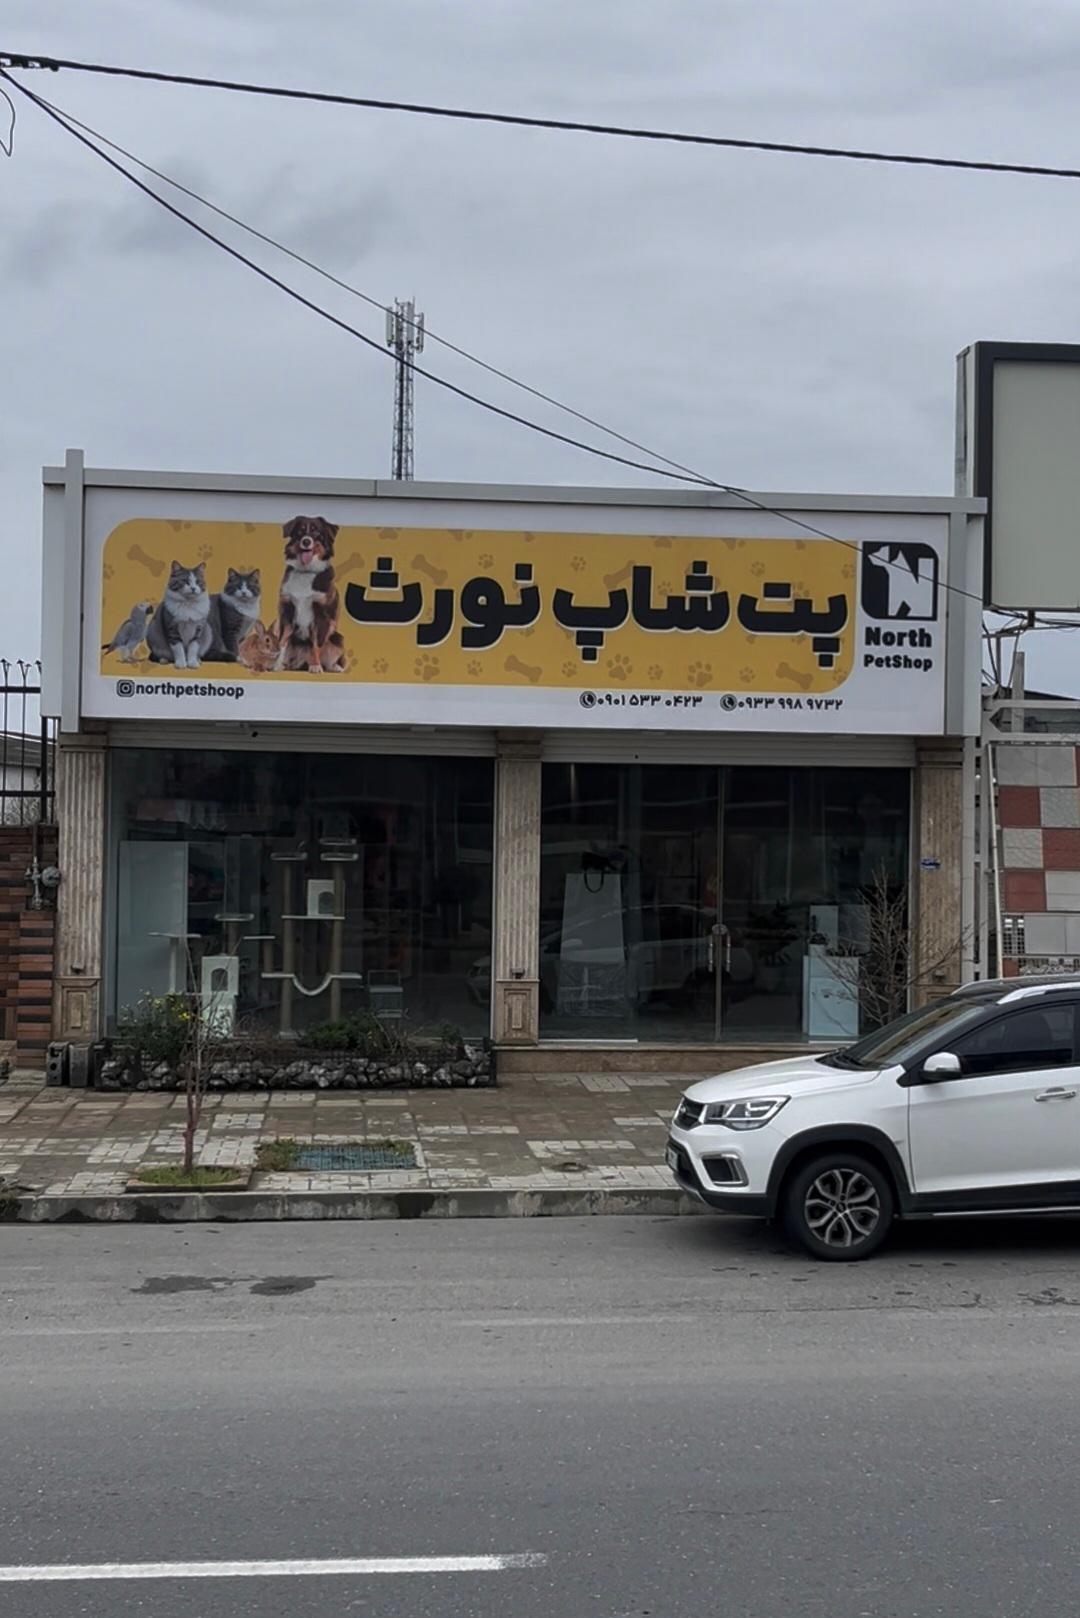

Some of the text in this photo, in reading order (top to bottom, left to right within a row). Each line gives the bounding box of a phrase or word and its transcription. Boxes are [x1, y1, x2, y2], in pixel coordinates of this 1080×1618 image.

[344, 556, 848, 668] پت شاپ نورث
[864, 626, 933, 648] North
[863, 653, 933, 672] PetShop
[136, 681, 245, 699] northpetshoop
